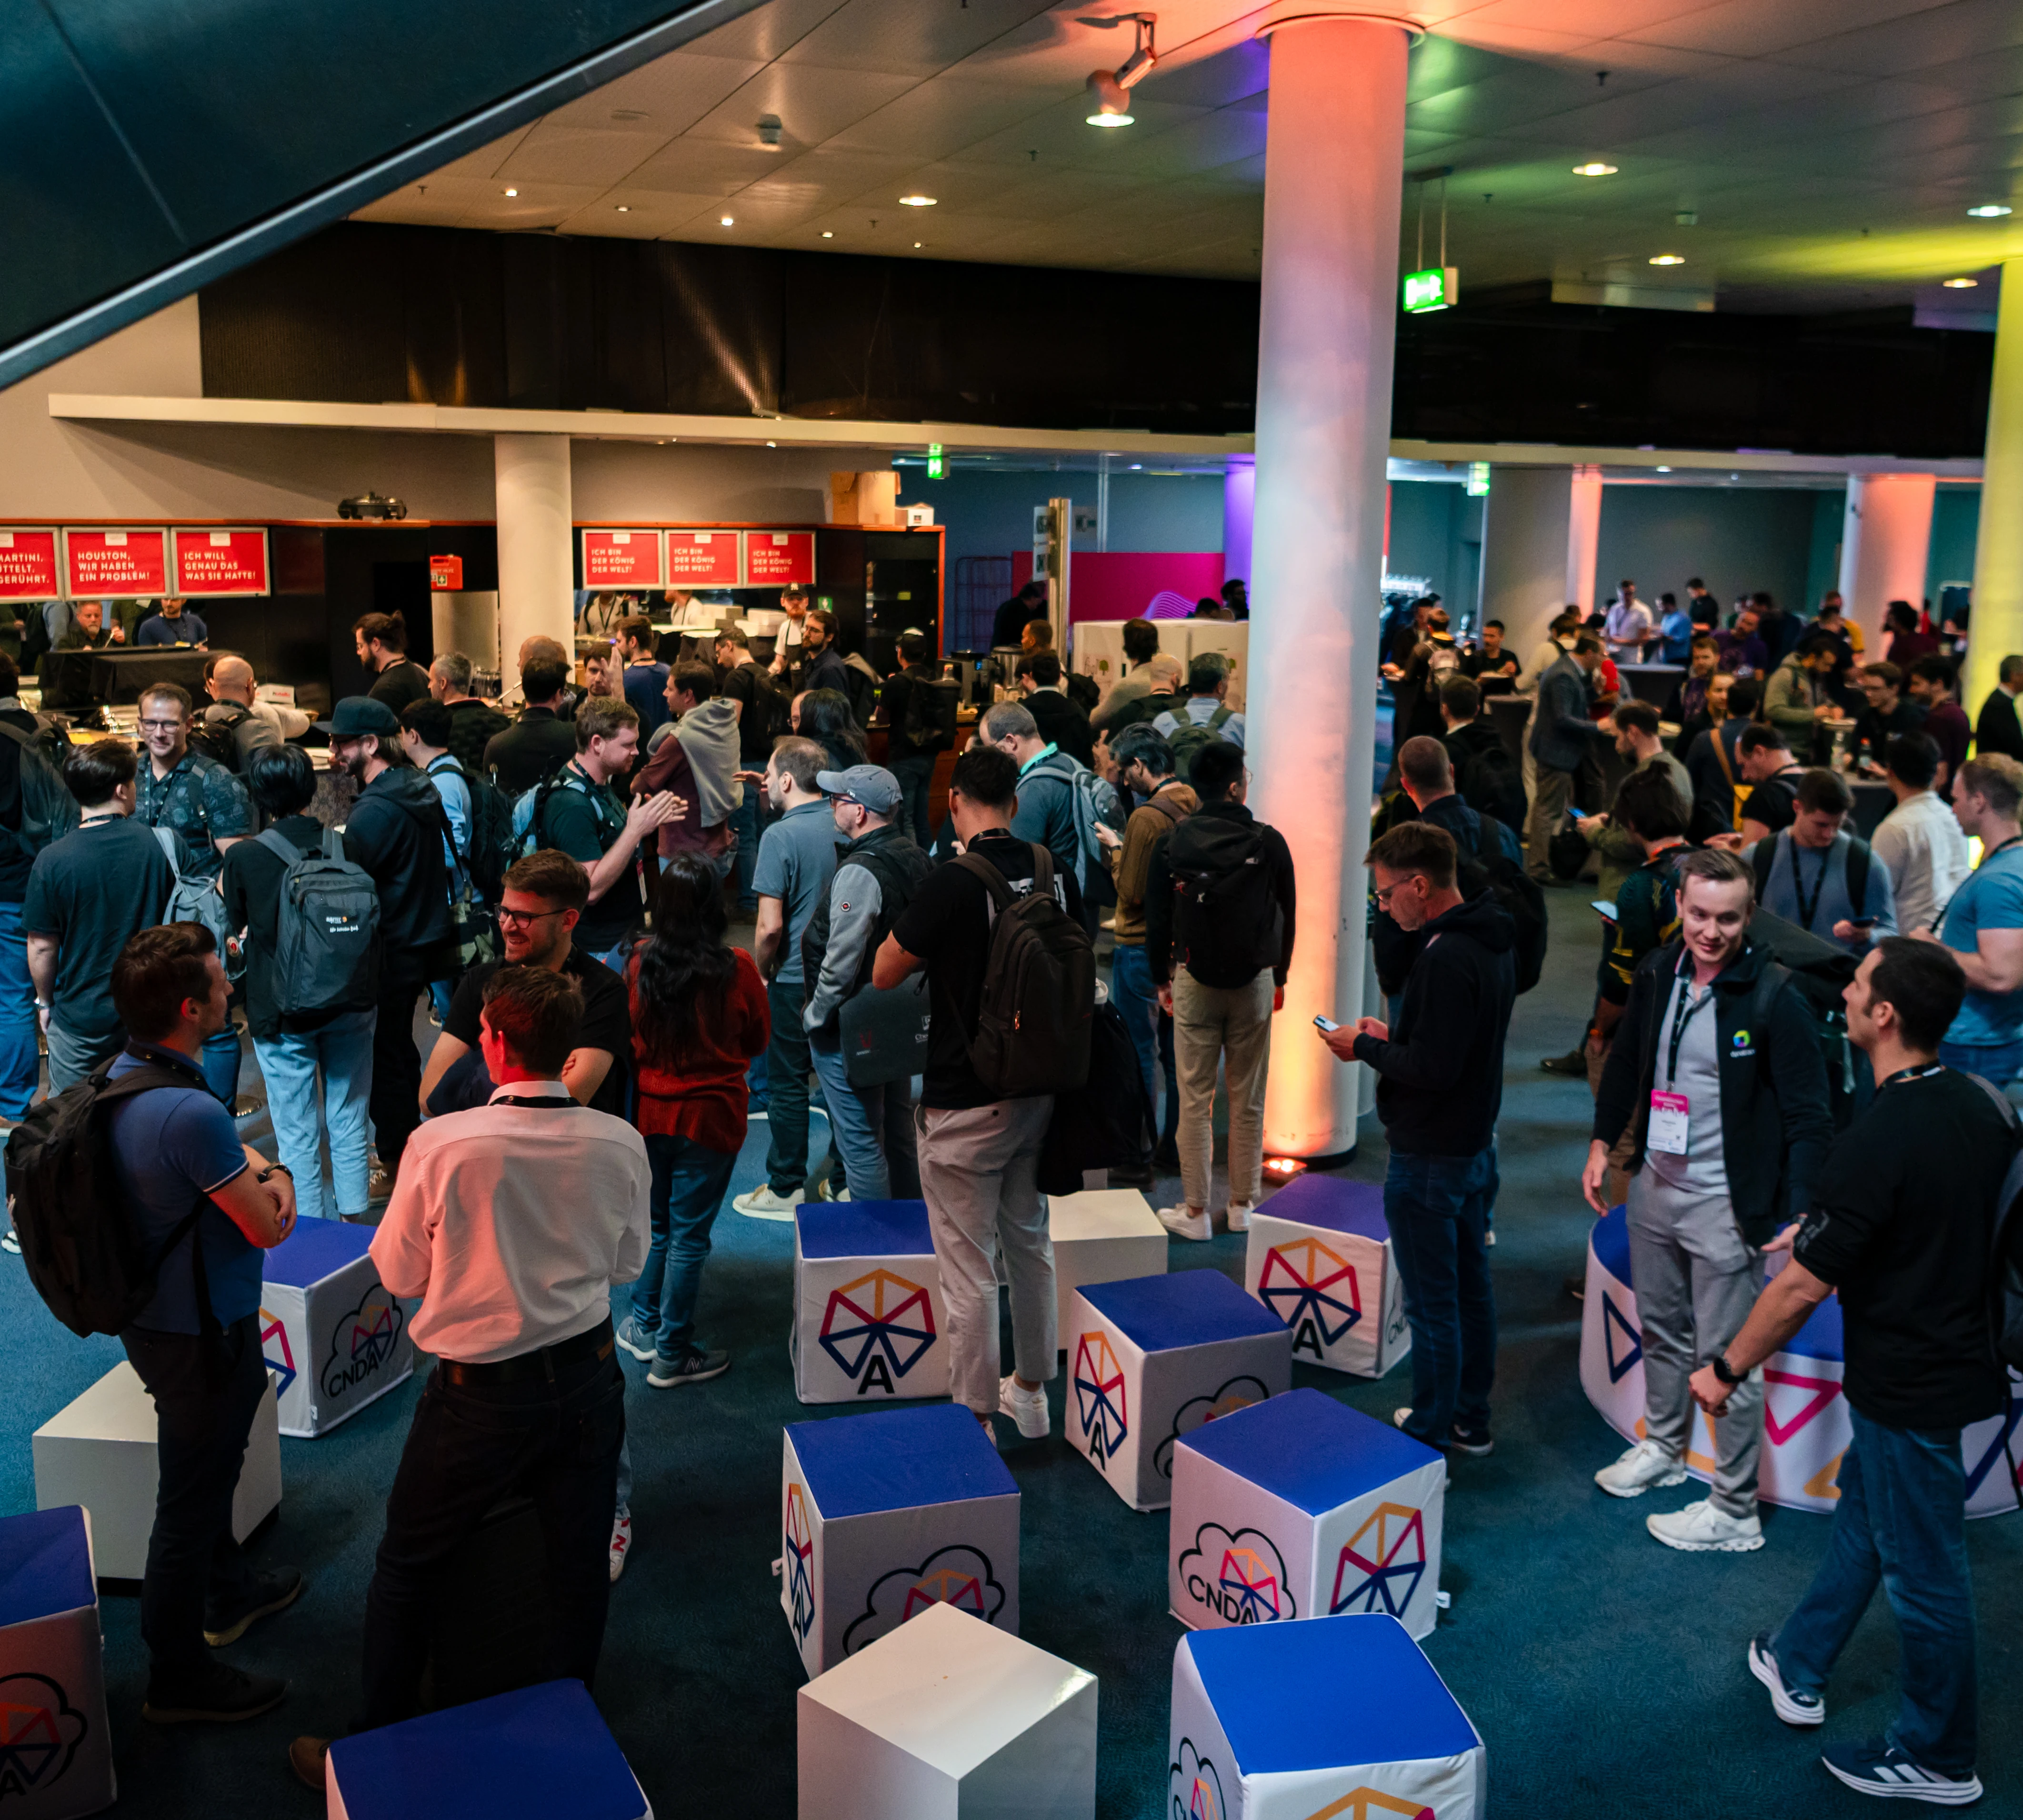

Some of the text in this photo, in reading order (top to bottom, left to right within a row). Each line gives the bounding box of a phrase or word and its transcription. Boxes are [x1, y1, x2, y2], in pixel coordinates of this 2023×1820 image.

[78, 551, 130, 561] HOUSTON,
[184, 552, 225, 560] ICH WILL
[610, 556, 635, 564] KÖNIG
[691, 556, 715, 564] KÖNIG
[78, 561, 134, 571] WIR HABEN
[185, 561, 238, 570] GENAU DAS
[79, 572, 150, 582] EIN PROBLEM!
[185, 571, 256, 580] WAS SIE HATTE!
[329, 1351, 379, 1398] CNDA
[1188, 1574, 1254, 1625] CNDA
